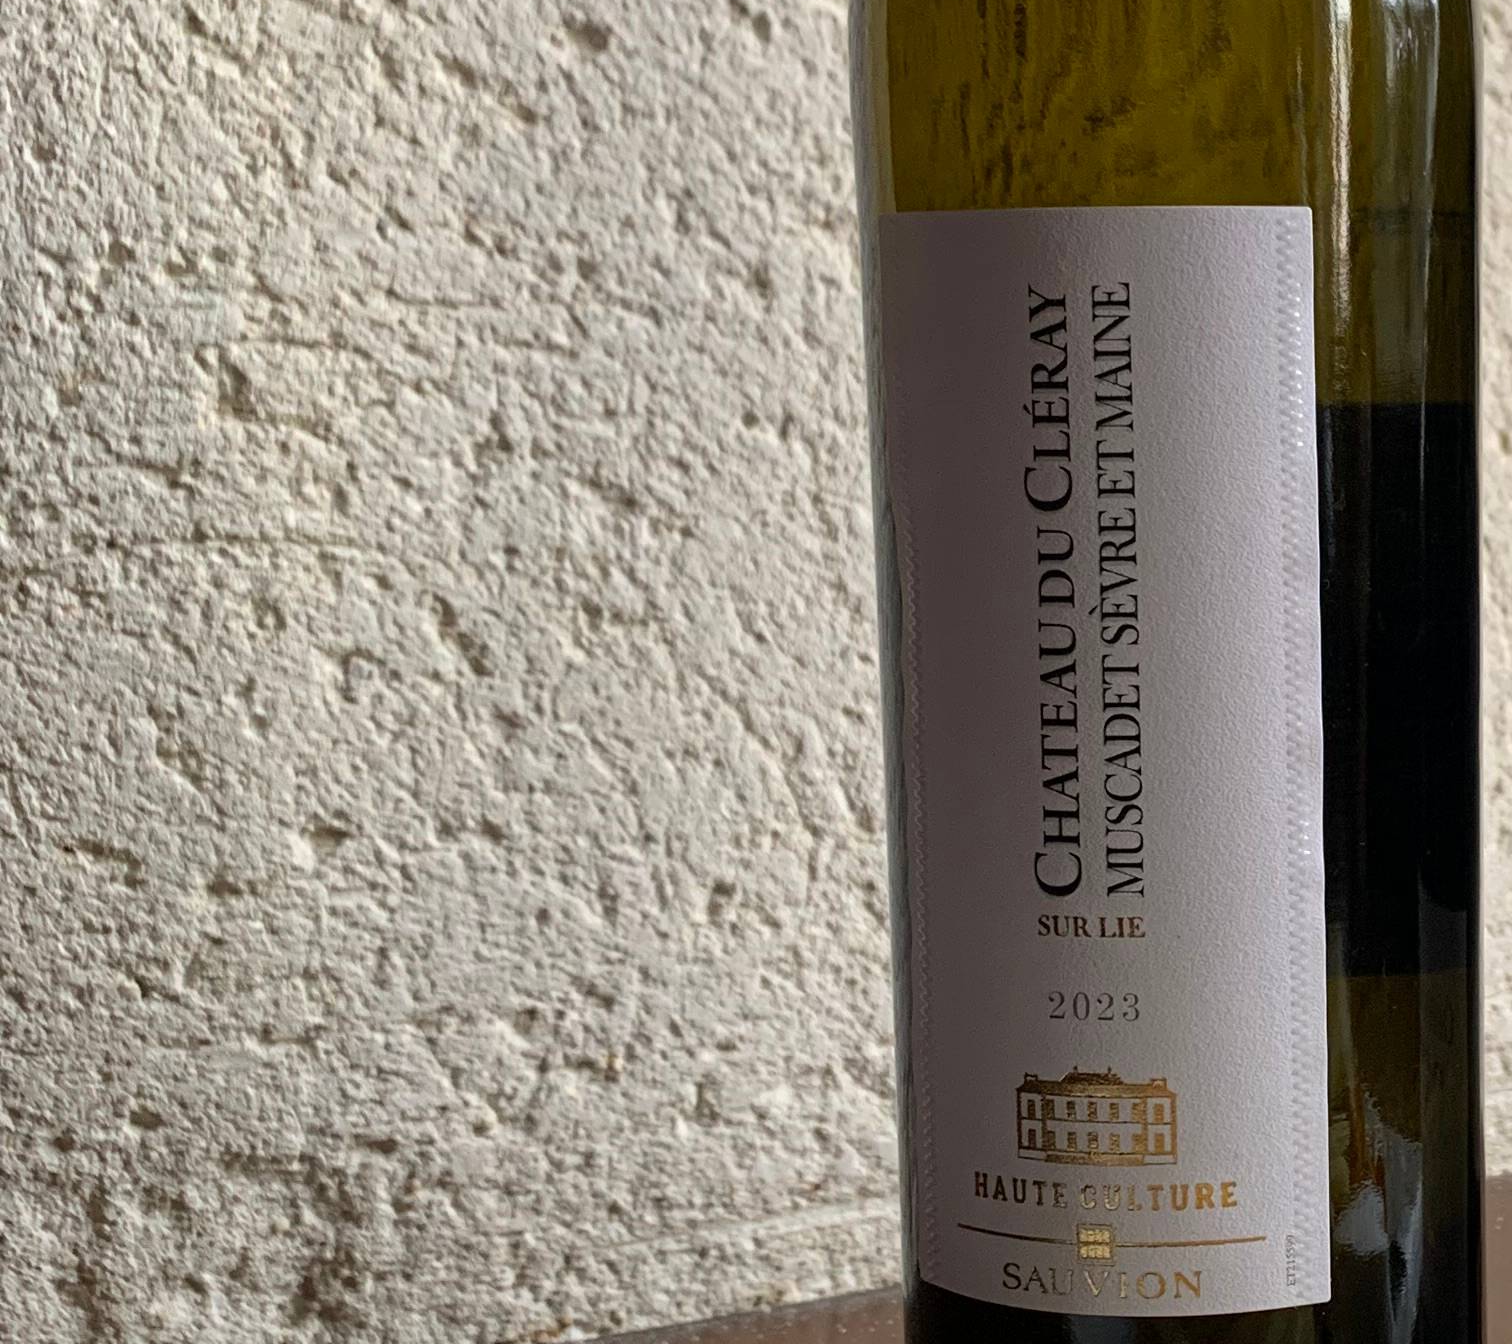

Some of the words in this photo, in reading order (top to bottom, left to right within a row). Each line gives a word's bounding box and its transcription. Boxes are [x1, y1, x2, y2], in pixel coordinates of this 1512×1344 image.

[1023, 283, 1074, 513] CLÉRAY
[1091, 281, 1135, 430] MAINE
[1097, 440, 1136, 498] ET
[1037, 525, 1075, 610] DU
[1088, 507, 1140, 646] SÈVRE
[1034, 618, 1082, 897] CHATEAU
[1102, 654, 1145, 897] MUSCADET
[1037, 913, 1091, 938] SUR
[1099, 914, 1147, 939] LIE
[1047, 990, 1141, 1022] 2023
[973, 1171, 1068, 1208] HAUTE
[1080, 1180, 1239, 1212] CULTURE
[1002, 1262, 1204, 1299] SAUVION
